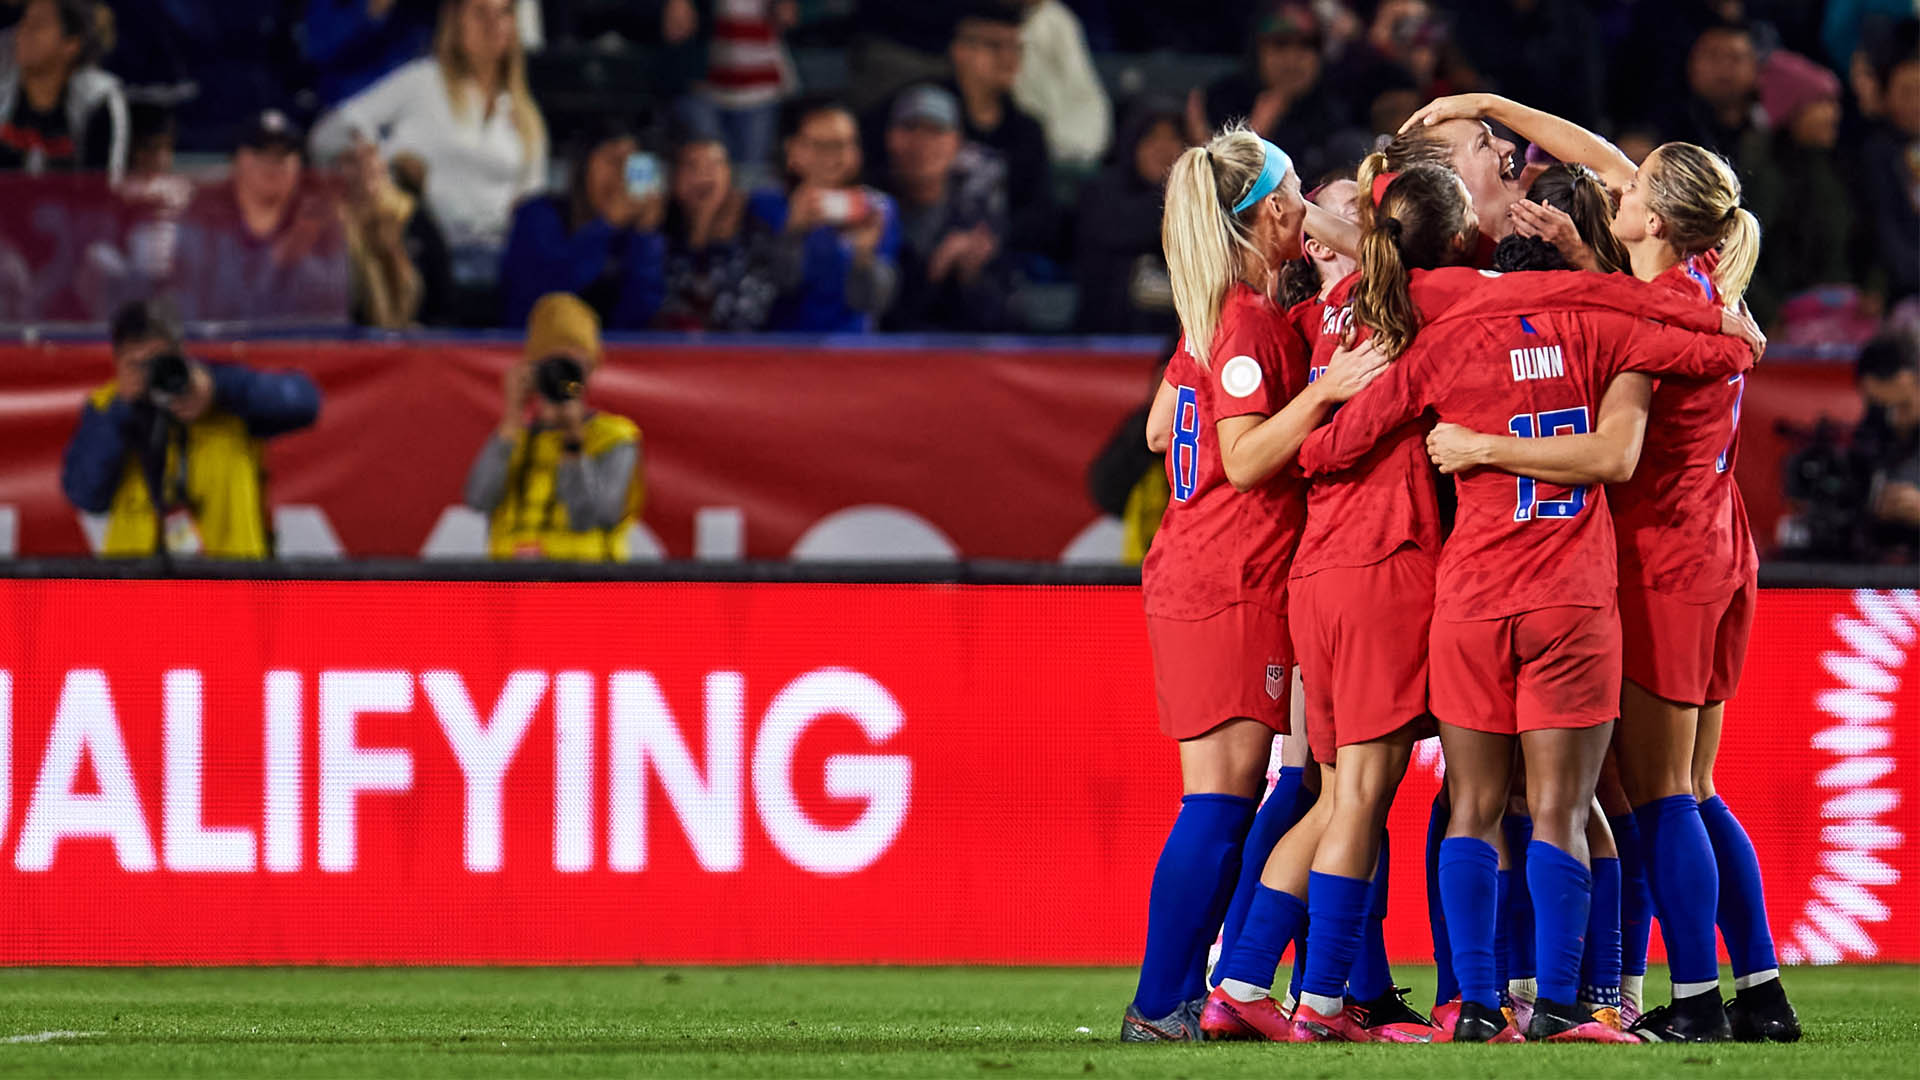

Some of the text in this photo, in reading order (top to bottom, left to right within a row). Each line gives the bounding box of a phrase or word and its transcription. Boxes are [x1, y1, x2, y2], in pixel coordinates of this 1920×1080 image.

[1510, 345, 1564, 382] DUNN
[1172, 385, 1200, 503] 8
[1508, 406, 1590, 522] 19
[0, 665, 913, 877] ALIFYING
